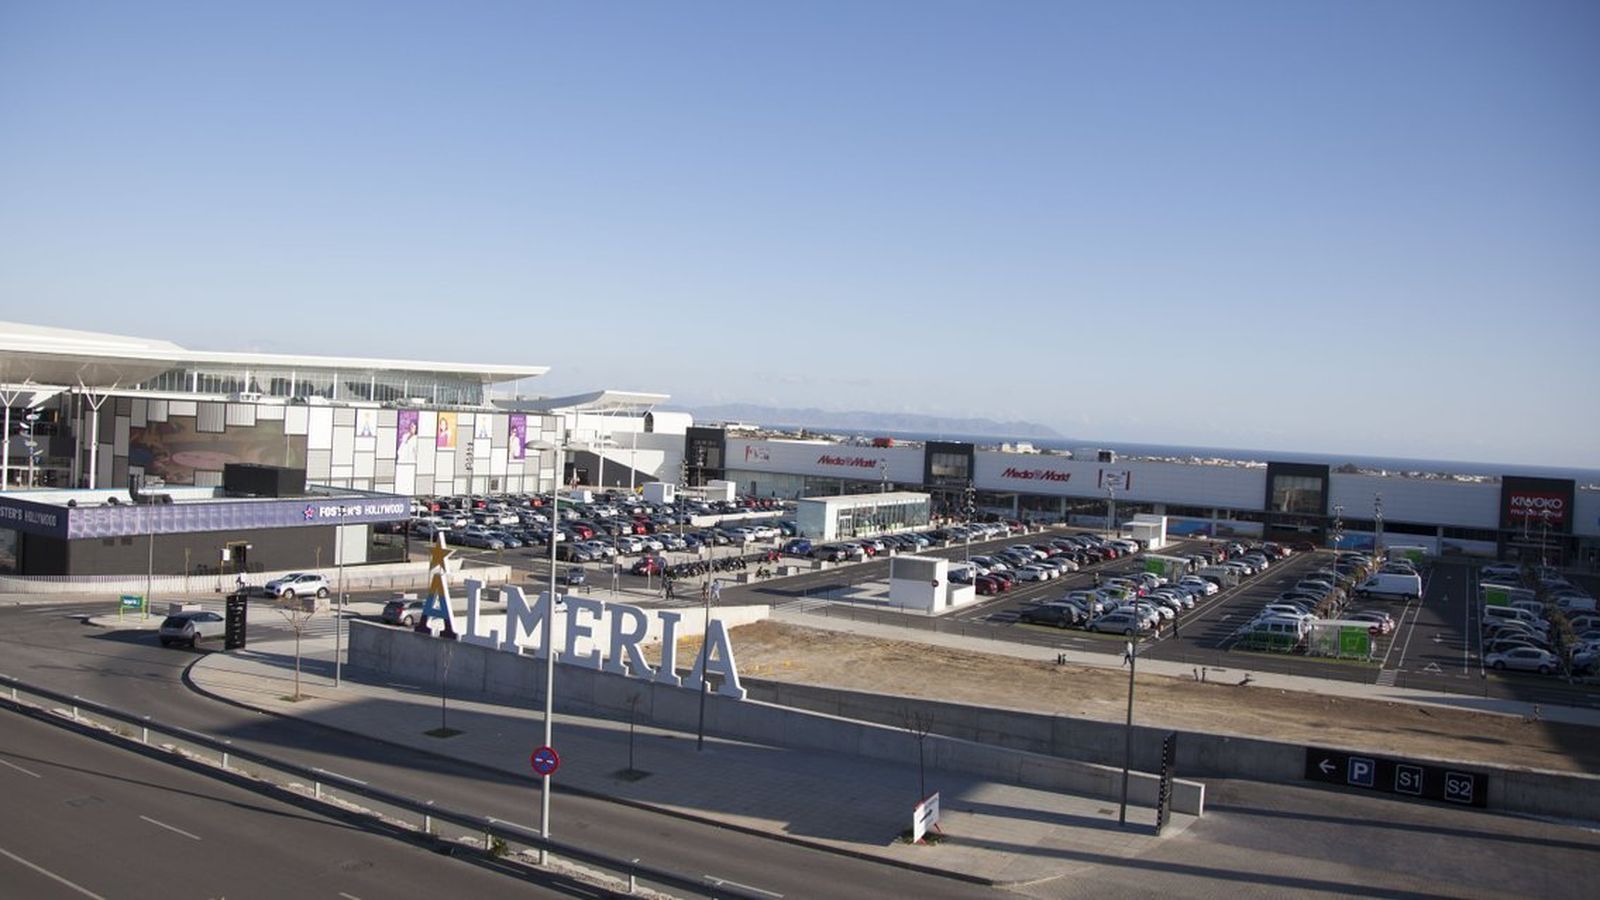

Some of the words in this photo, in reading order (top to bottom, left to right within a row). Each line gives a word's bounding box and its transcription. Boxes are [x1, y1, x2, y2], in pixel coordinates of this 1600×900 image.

[364, 503, 404, 515] HOLLYWOOD
[1511, 495, 1564, 509] KIWOKO
[24, 509, 57, 527] HOLLYWOOD
[414, 570, 747, 700] ALMERIA
[1353, 762, 1368, 780] P
[1399, 771, 1419, 788] S1
[1447, 779, 1471, 796] S2
